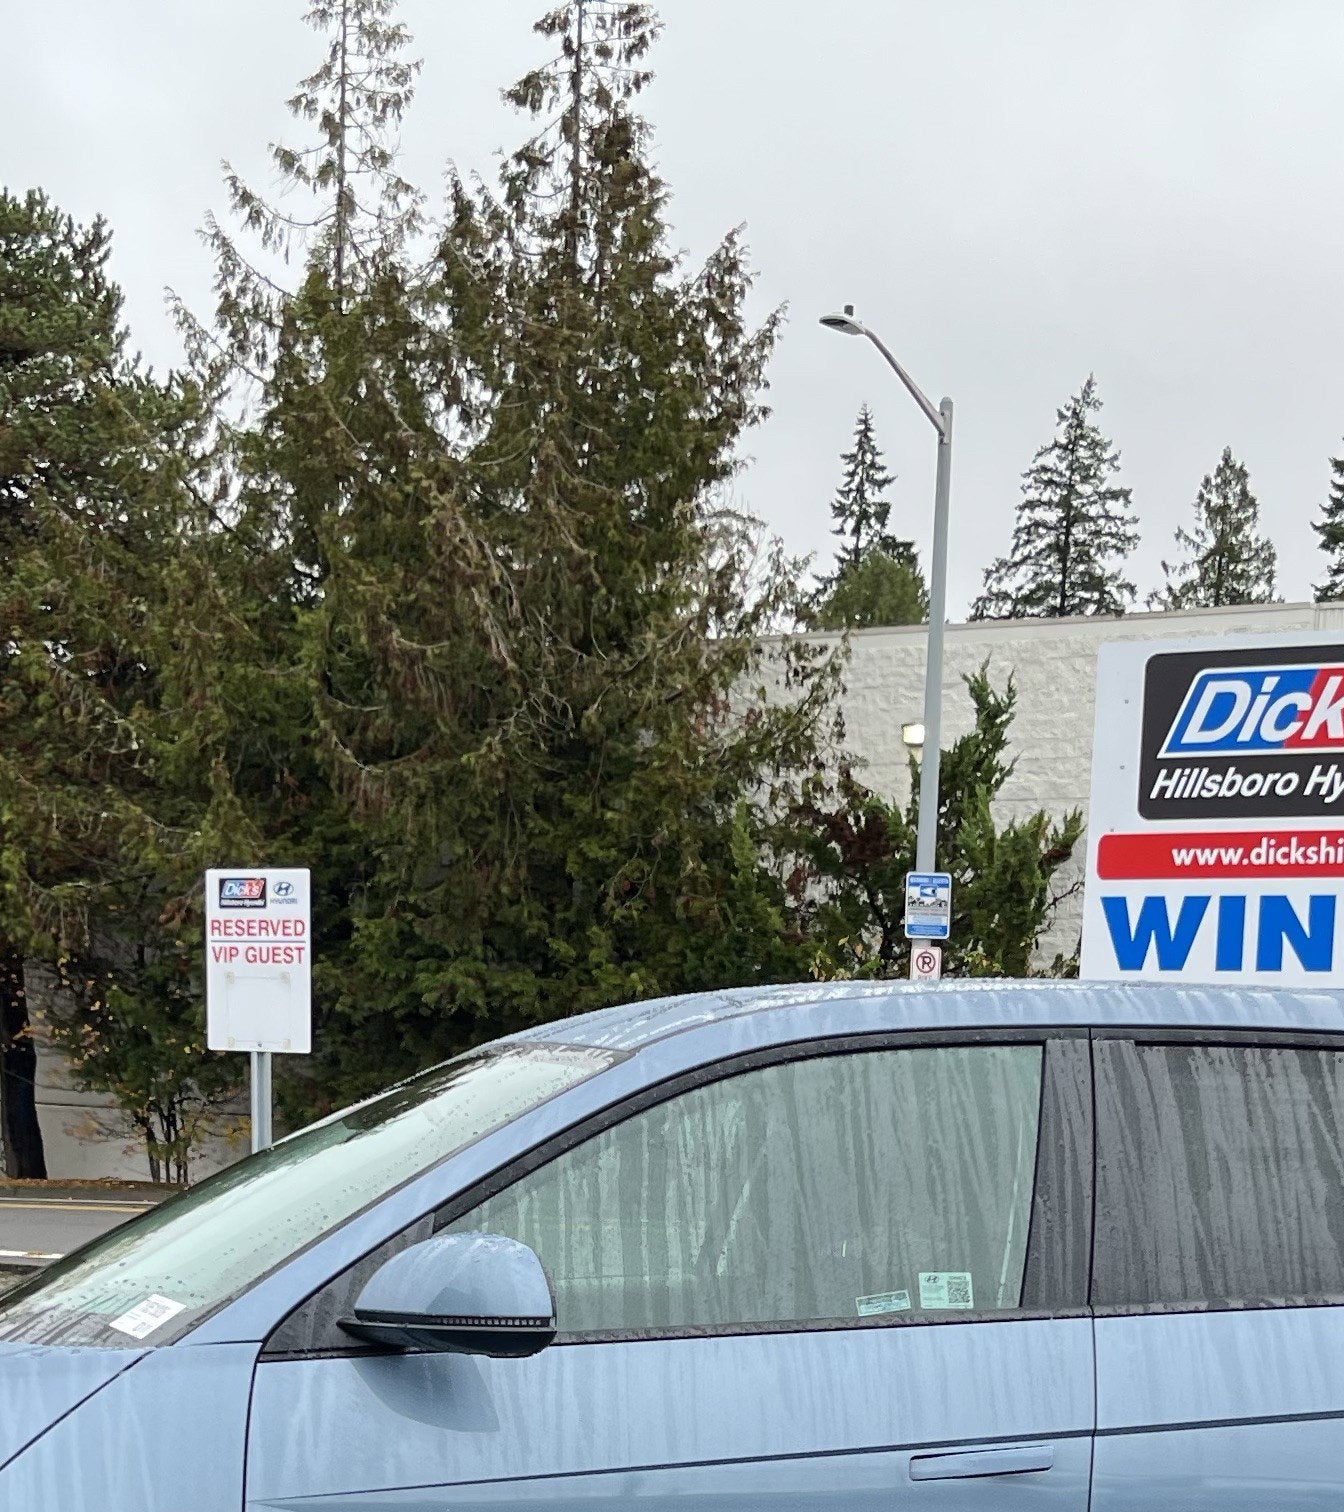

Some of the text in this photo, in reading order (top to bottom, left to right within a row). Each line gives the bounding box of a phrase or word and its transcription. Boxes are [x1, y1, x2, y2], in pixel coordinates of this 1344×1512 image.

[1149, 767, 1300, 799] Hillsboro
[211, 919, 305, 937] RESERVED
[212, 946, 305, 964] VIP GUEST
